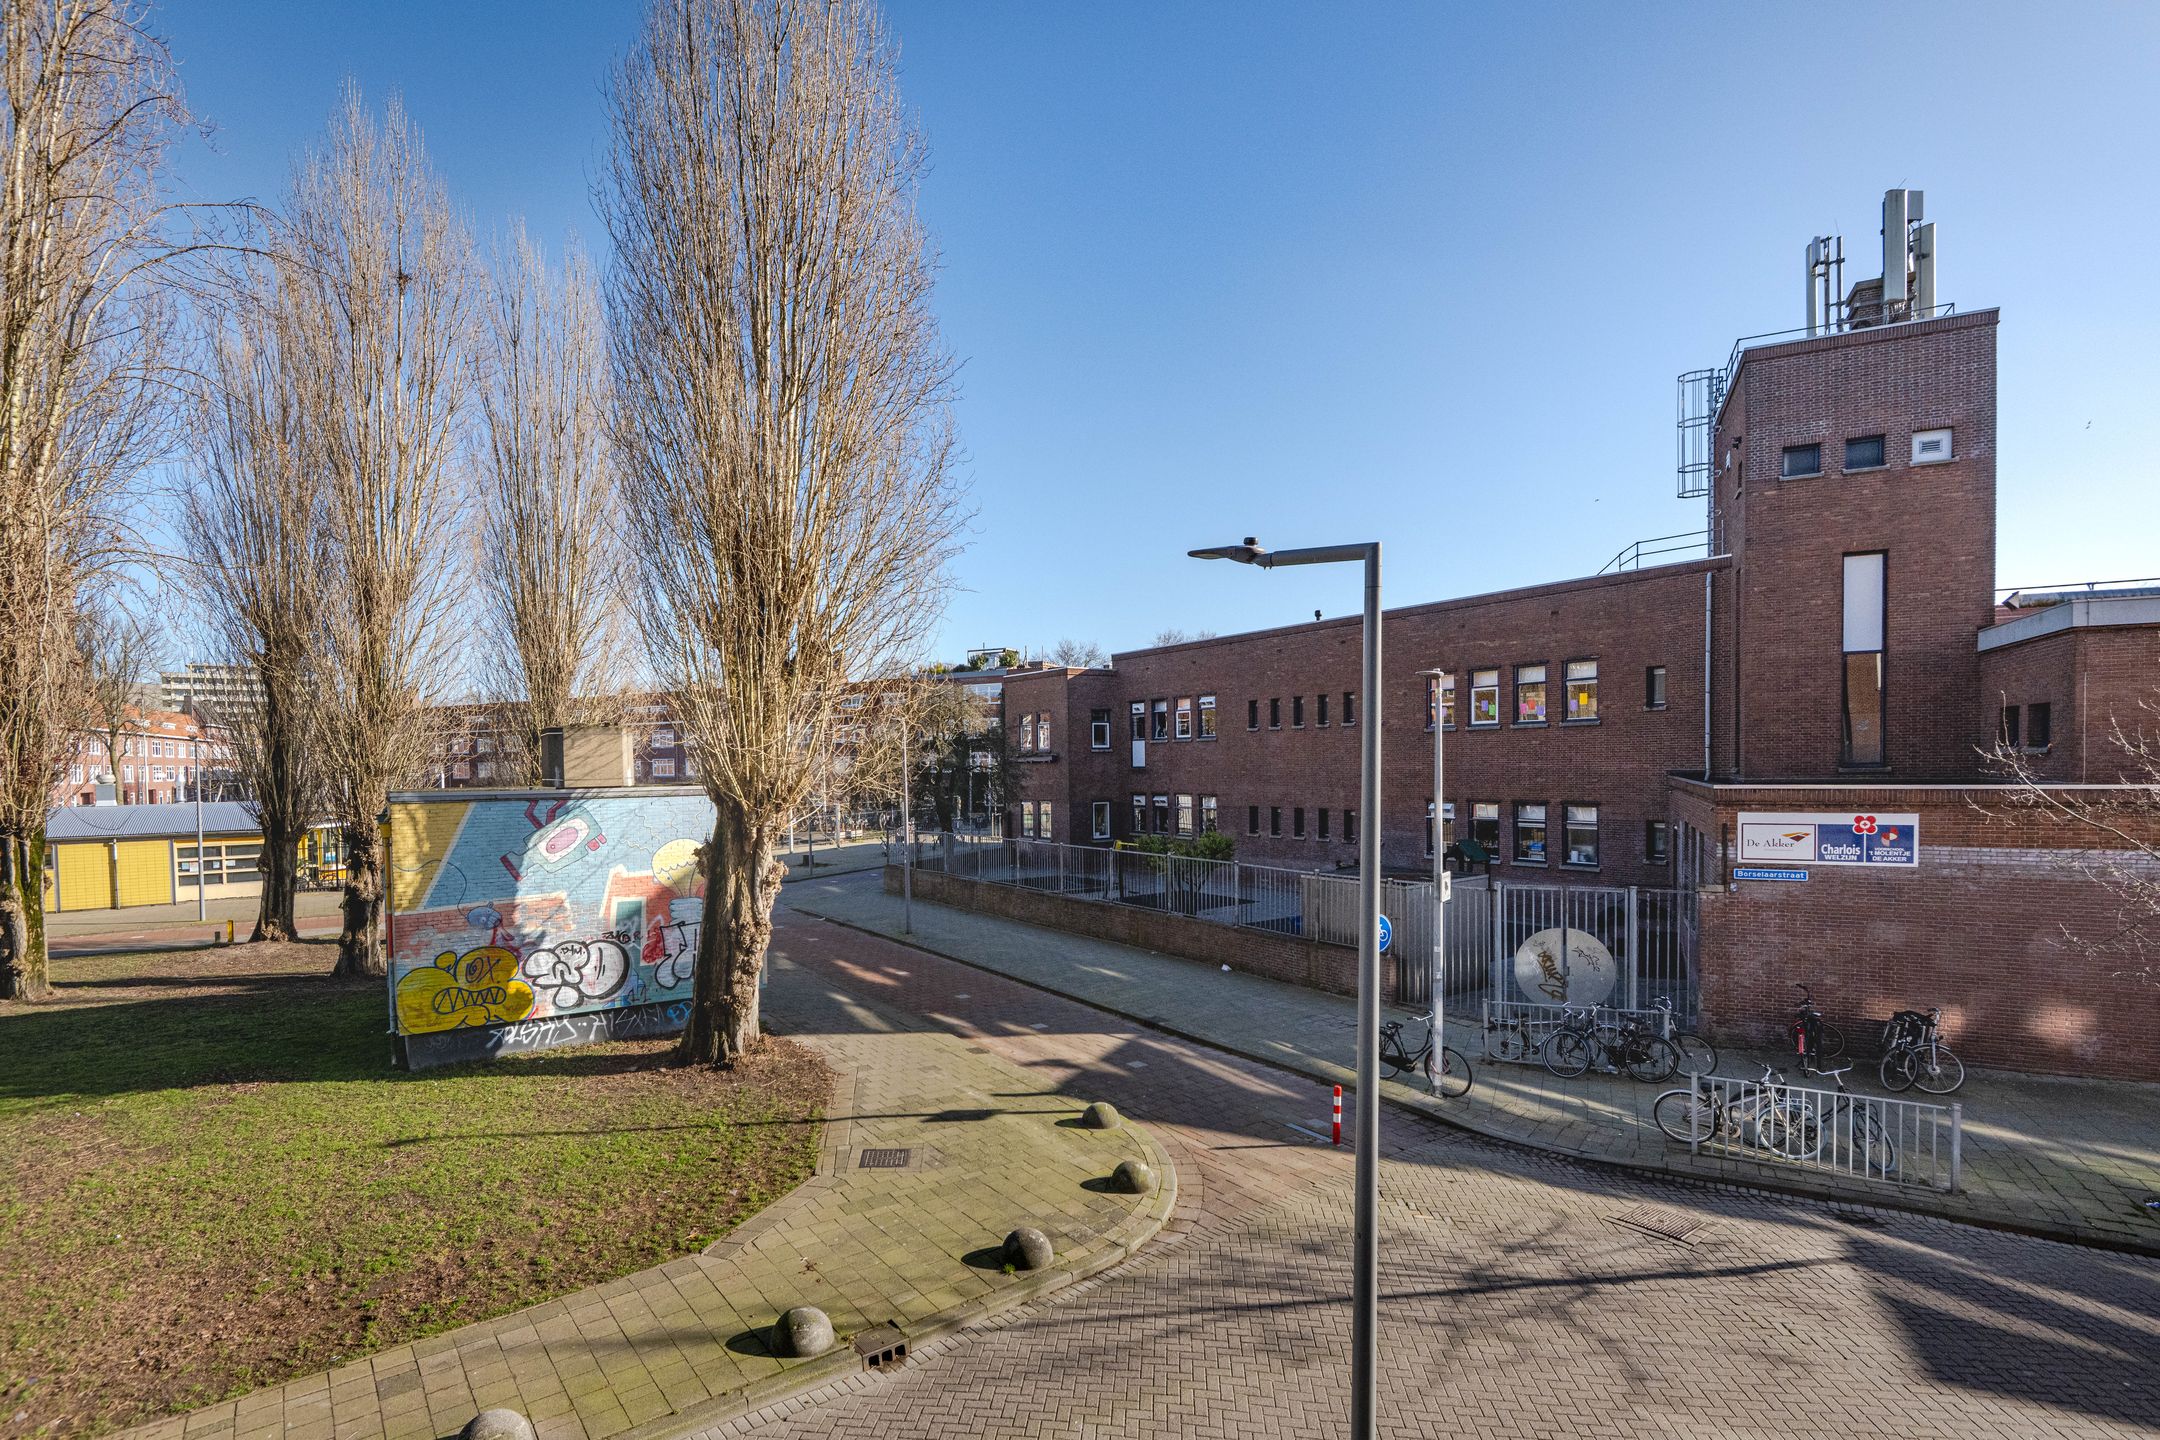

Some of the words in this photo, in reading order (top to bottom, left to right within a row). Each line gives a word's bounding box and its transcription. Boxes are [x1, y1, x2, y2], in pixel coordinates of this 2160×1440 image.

[1746, 839, 1760, 847] De
[1763, 838, 1795, 848] Akker
[1820, 843, 1861, 855] Charlois
[1737, 870, 1805, 879] Borselaarstraat
